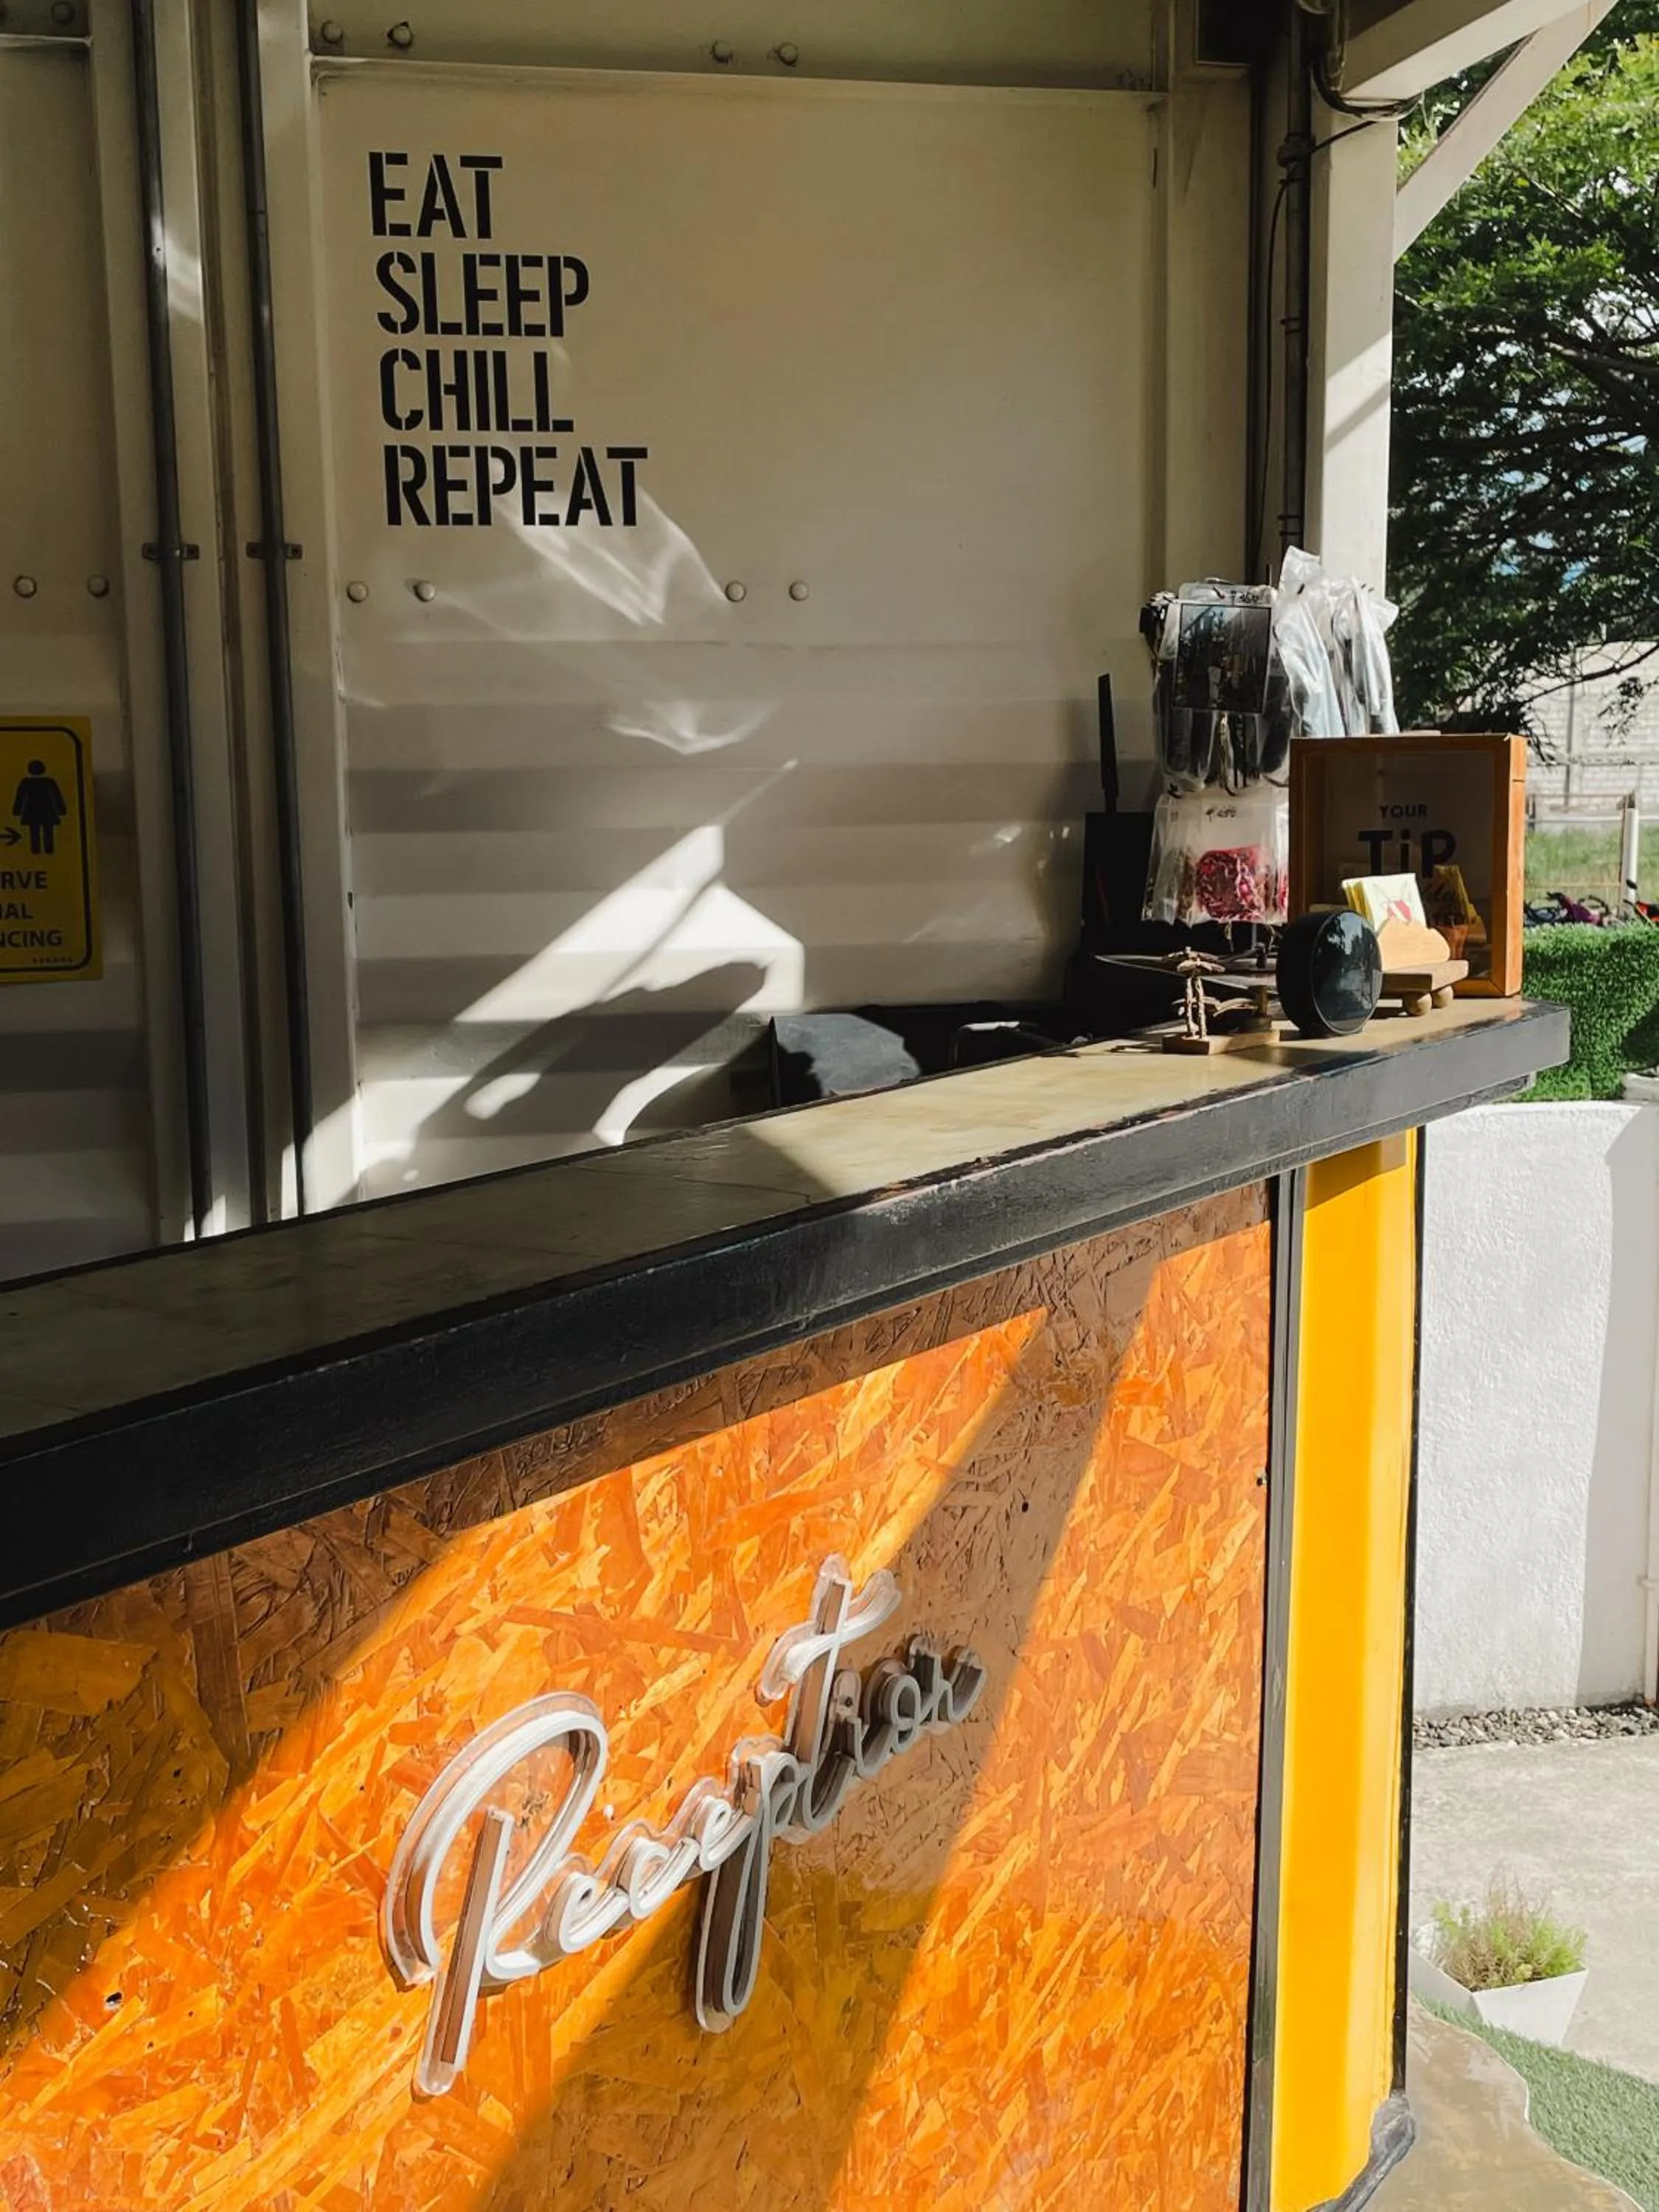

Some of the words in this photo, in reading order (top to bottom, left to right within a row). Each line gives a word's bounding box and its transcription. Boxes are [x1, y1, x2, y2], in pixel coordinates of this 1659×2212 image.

[369, 151, 503, 239] EAT
[375, 251, 589, 337] SLEEP
[379, 348, 574, 432] CHILL
[383, 445, 648, 526] REPEAT
[1379, 804, 1428, 818] YOUR
[386, 1554, 987, 2096] Reception
